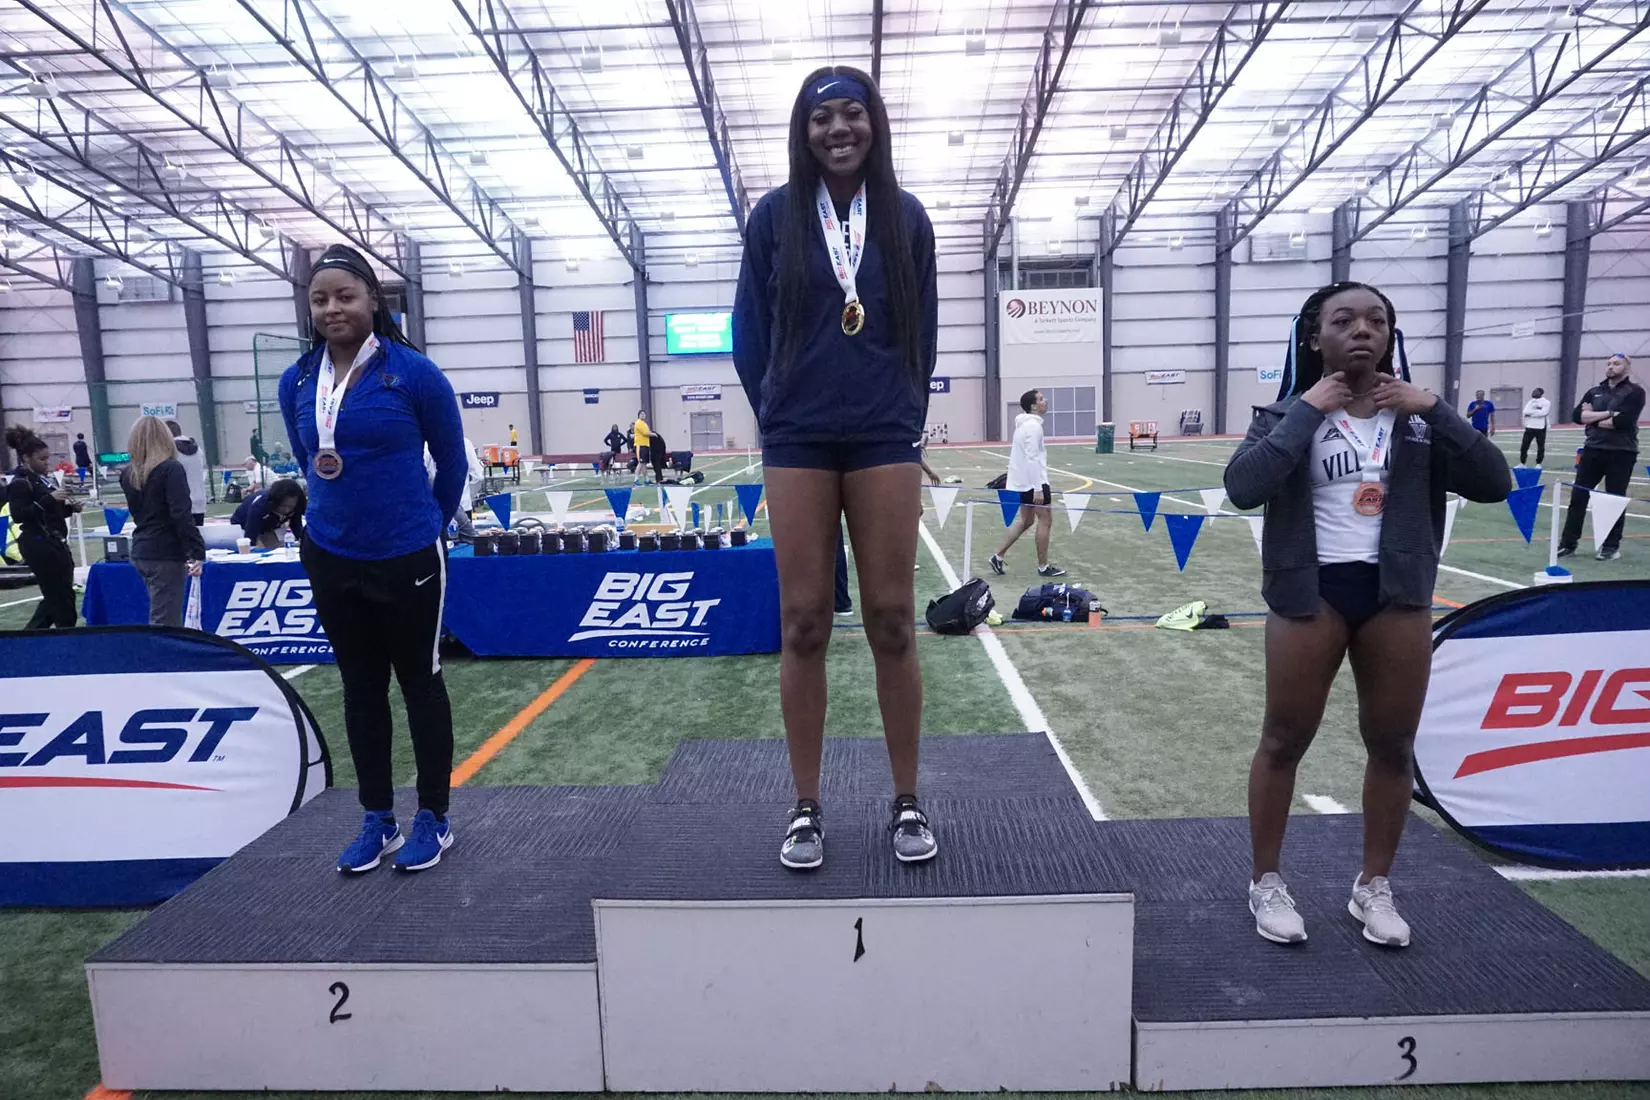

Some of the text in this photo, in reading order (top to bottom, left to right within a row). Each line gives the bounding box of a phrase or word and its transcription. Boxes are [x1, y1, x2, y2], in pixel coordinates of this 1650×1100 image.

[1028, 300, 1097, 315] BEYNON
[1260, 371, 1281, 379] SoFi
[144, 406, 164, 416] SoFi
[466, 394, 494, 406] Jeep
[225, 579, 313, 610] BIG
[593, 571, 694, 601] BIG
[215, 609, 326, 637] EAS
[579, 598, 721, 628] EAST
[608, 637, 710, 648] CONFERENCE
[1480, 668, 1650, 729] BIG
[0, 707, 260, 767] EAST
[853, 917, 866, 962] 1
[329, 981, 352, 1024] 2
[1394, 1036, 1417, 1080] 3
